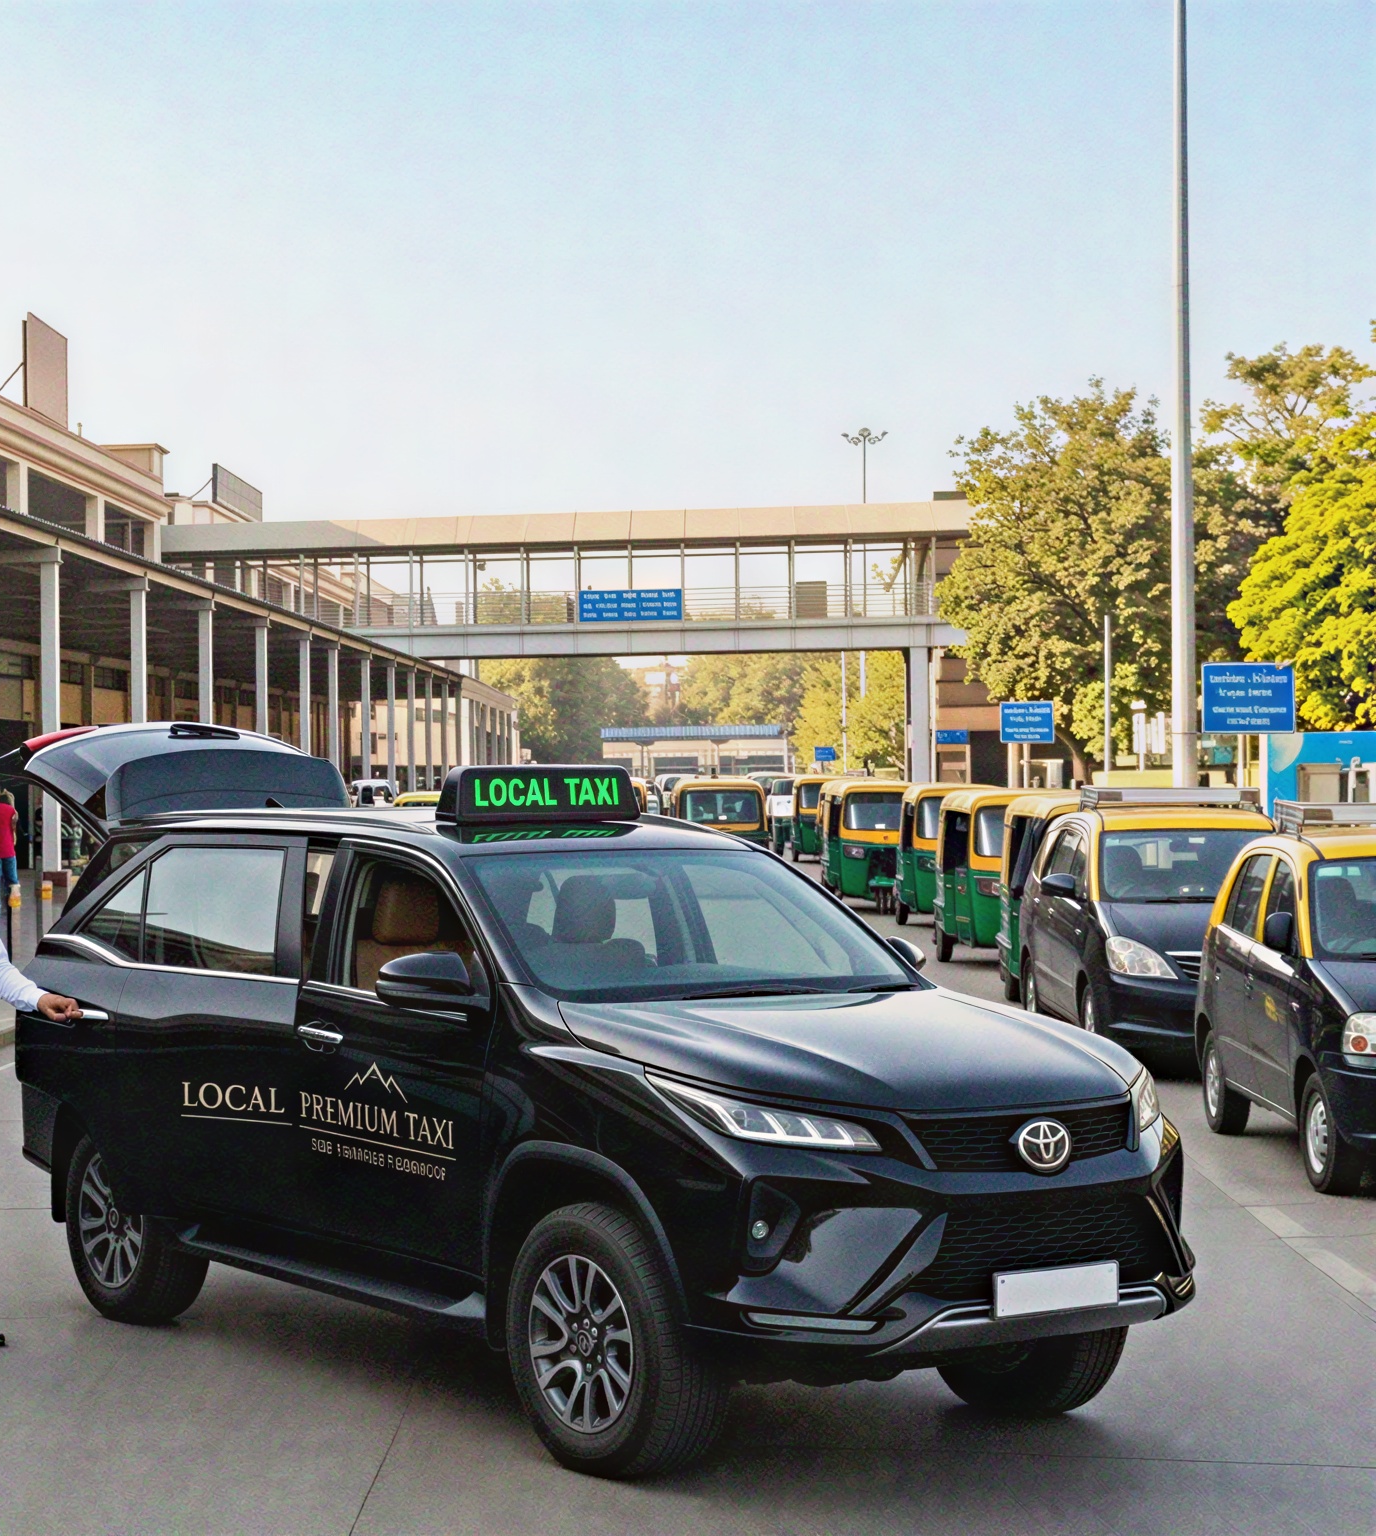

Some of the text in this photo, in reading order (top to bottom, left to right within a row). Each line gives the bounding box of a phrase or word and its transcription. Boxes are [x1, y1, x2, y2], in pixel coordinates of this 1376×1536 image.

[474, 776, 620, 808] LOCAL TAXI
[181, 1081, 455, 1150] LOCAL PREMIUM TAXI
